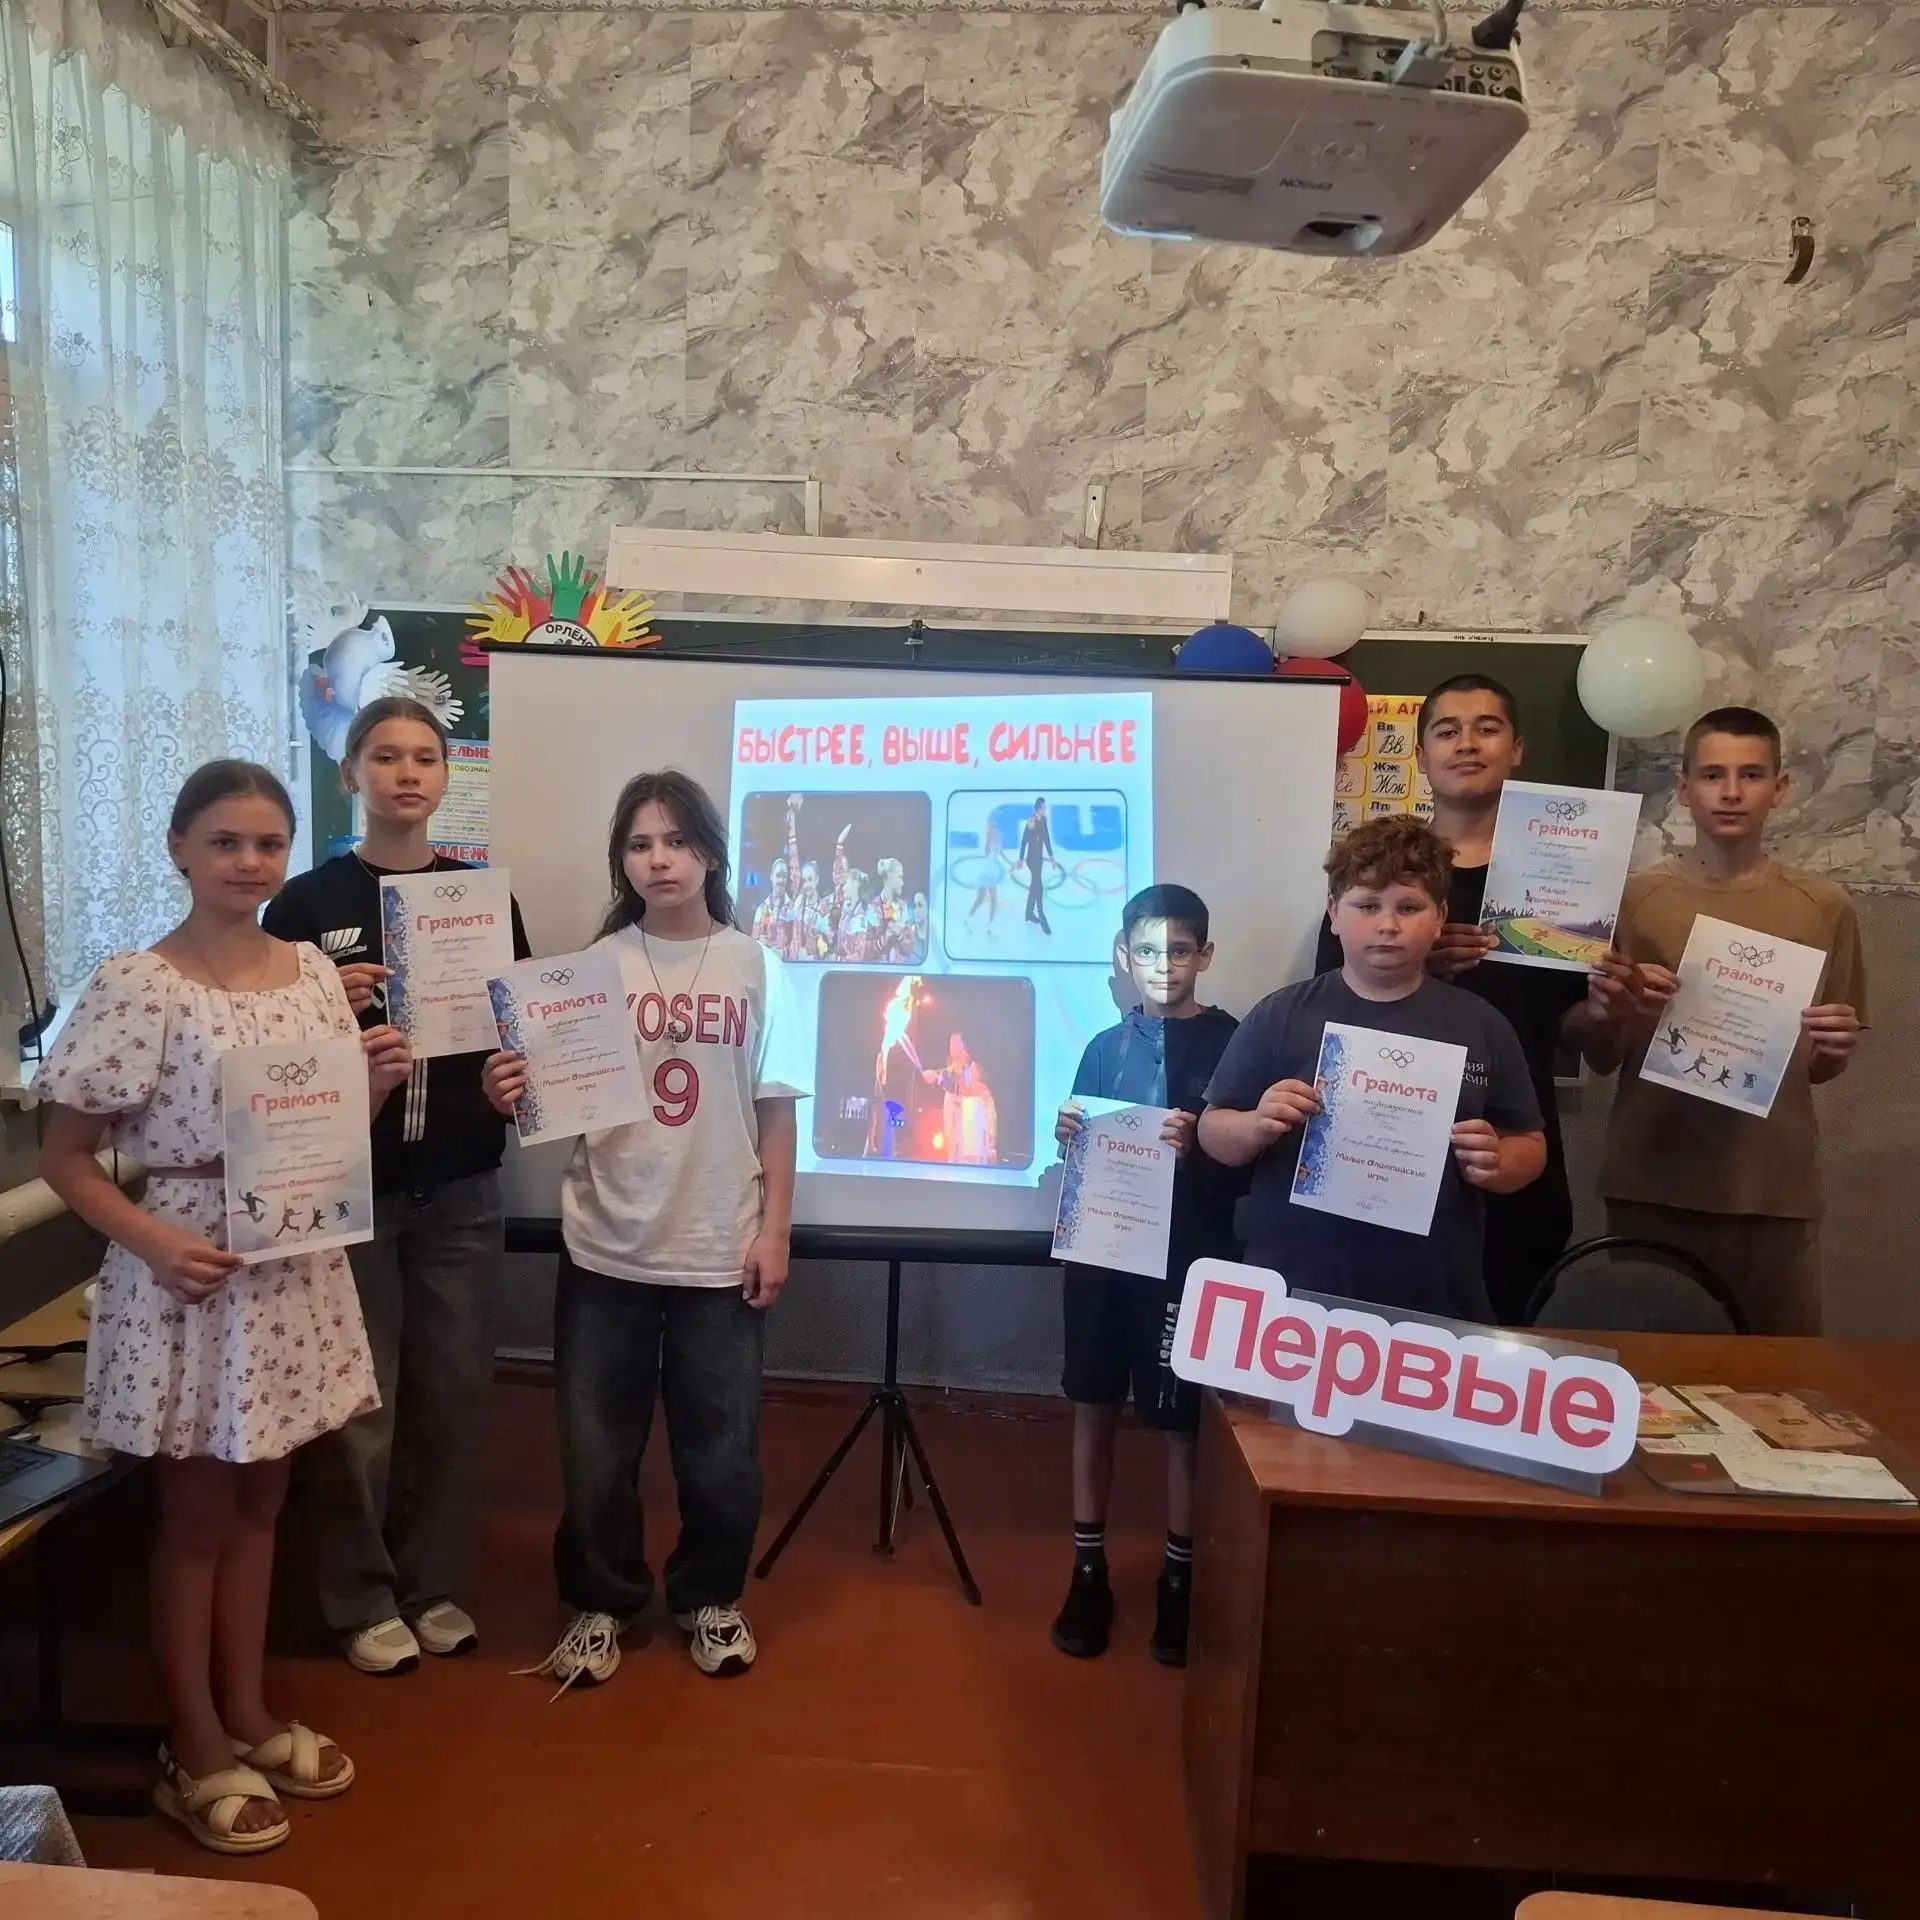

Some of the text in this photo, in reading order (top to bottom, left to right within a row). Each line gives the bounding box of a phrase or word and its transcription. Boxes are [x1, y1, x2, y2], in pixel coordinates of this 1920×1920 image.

[737, 720, 1136, 769] БЫСТРЕЕ, ВЫШЕ, СИЛЬНЕЕ
[1528, 818, 1599, 841] Грамота
[416, 912, 495, 935] Грамота
[1704, 957, 1786, 995] Грамота
[526, 992, 608, 1019] Грамота
[653, 1058, 699, 1126] 9
[1351, 1069, 1439, 1103] Грамота
[250, 1089, 341, 1115] Грамота
[1096, 1133, 1161, 1161] Грамота
[1189, 1280, 1615, 1449] Первые
